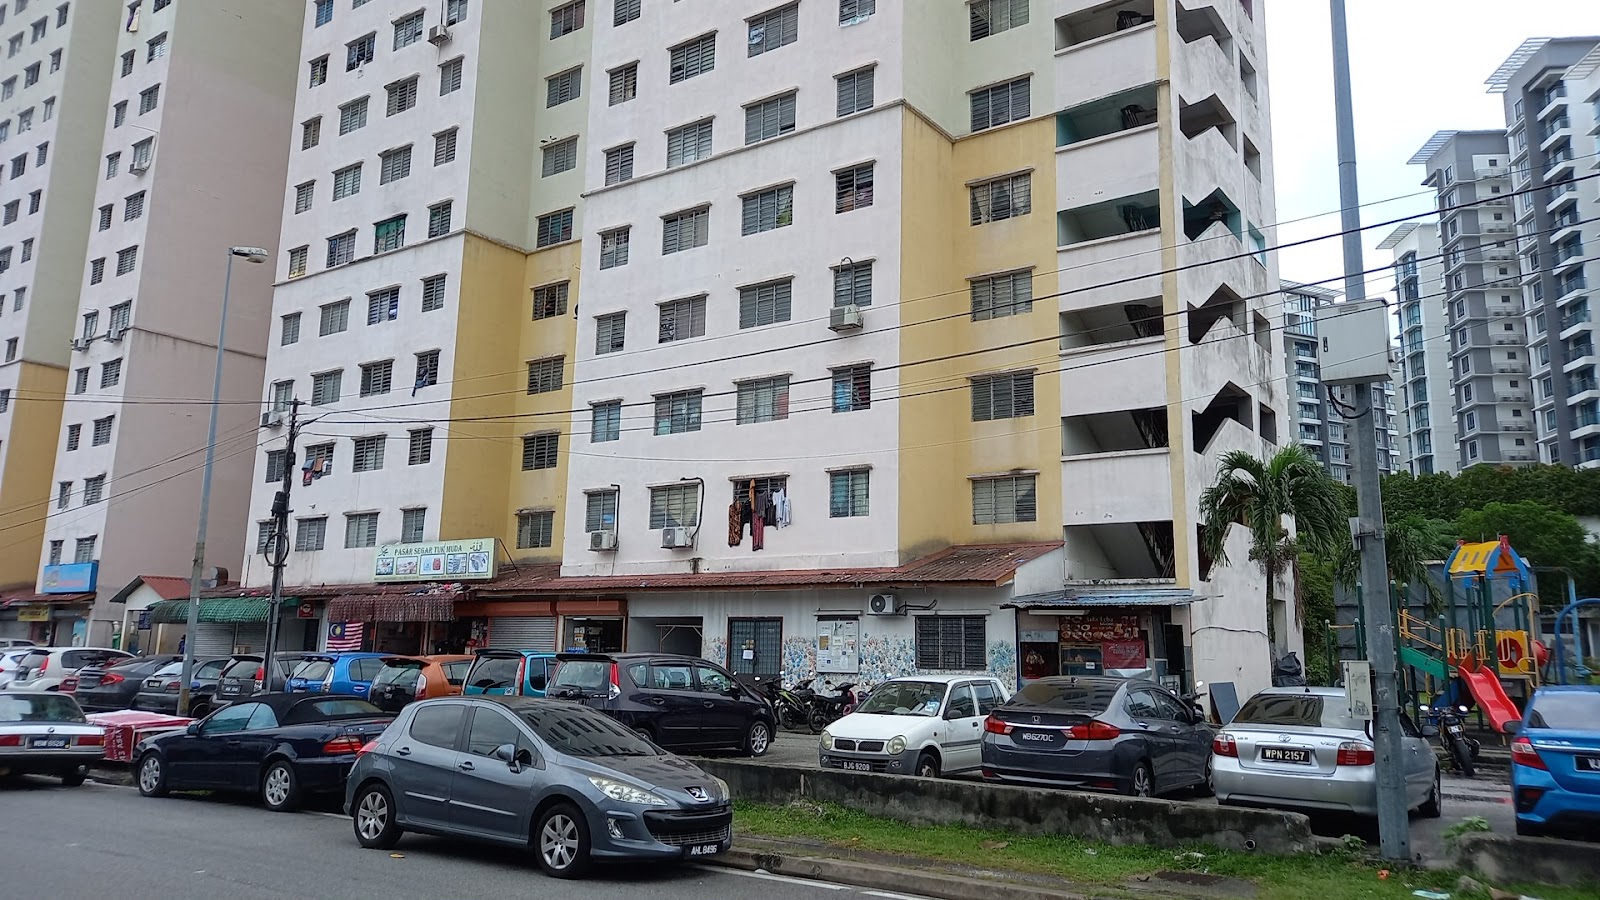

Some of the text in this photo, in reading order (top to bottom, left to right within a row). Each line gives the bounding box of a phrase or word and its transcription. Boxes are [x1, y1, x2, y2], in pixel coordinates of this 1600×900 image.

[394, 548, 412, 556] PASAR
[1265, 749, 1305, 761] WPN 2157
